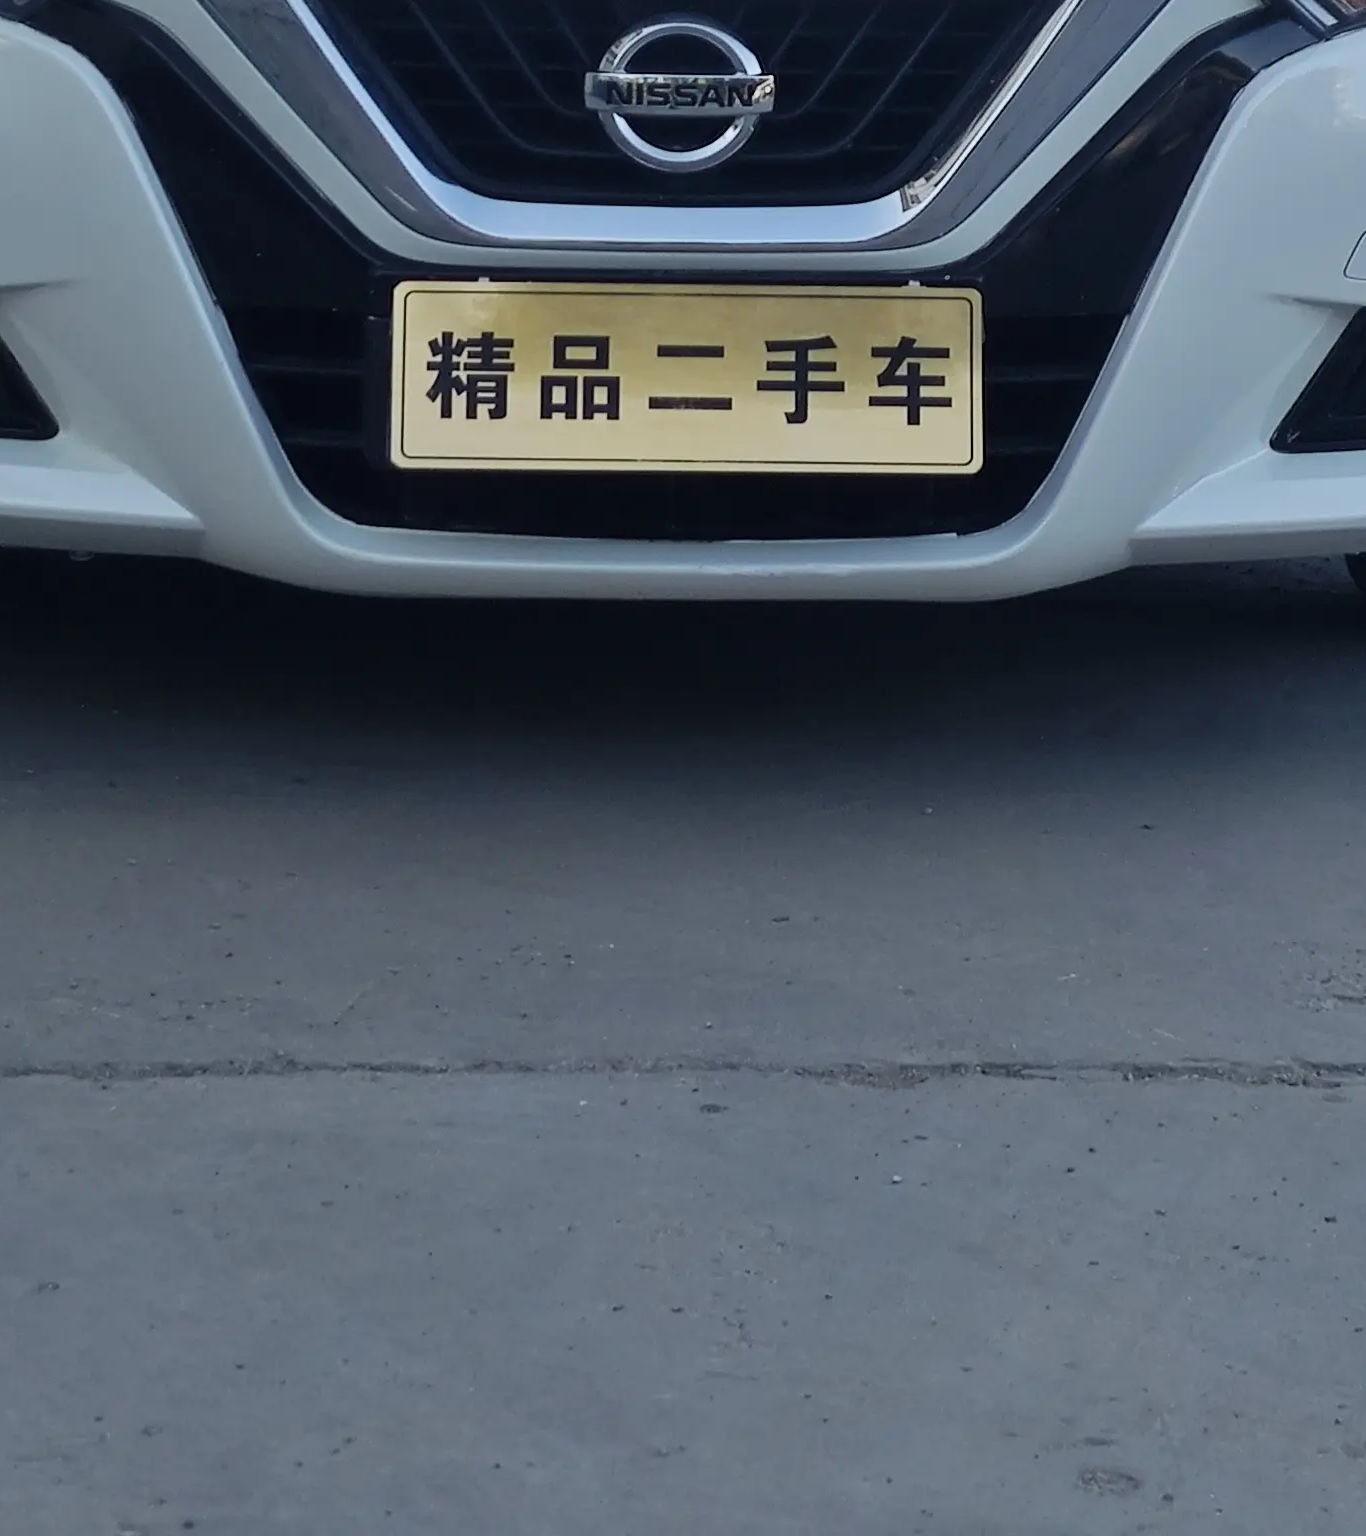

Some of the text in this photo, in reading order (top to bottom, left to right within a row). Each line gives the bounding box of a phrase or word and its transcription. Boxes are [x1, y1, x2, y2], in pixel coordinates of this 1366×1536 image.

[605, 82, 757, 108] NISSAN
[426, 331, 953, 426] 精品二手车
